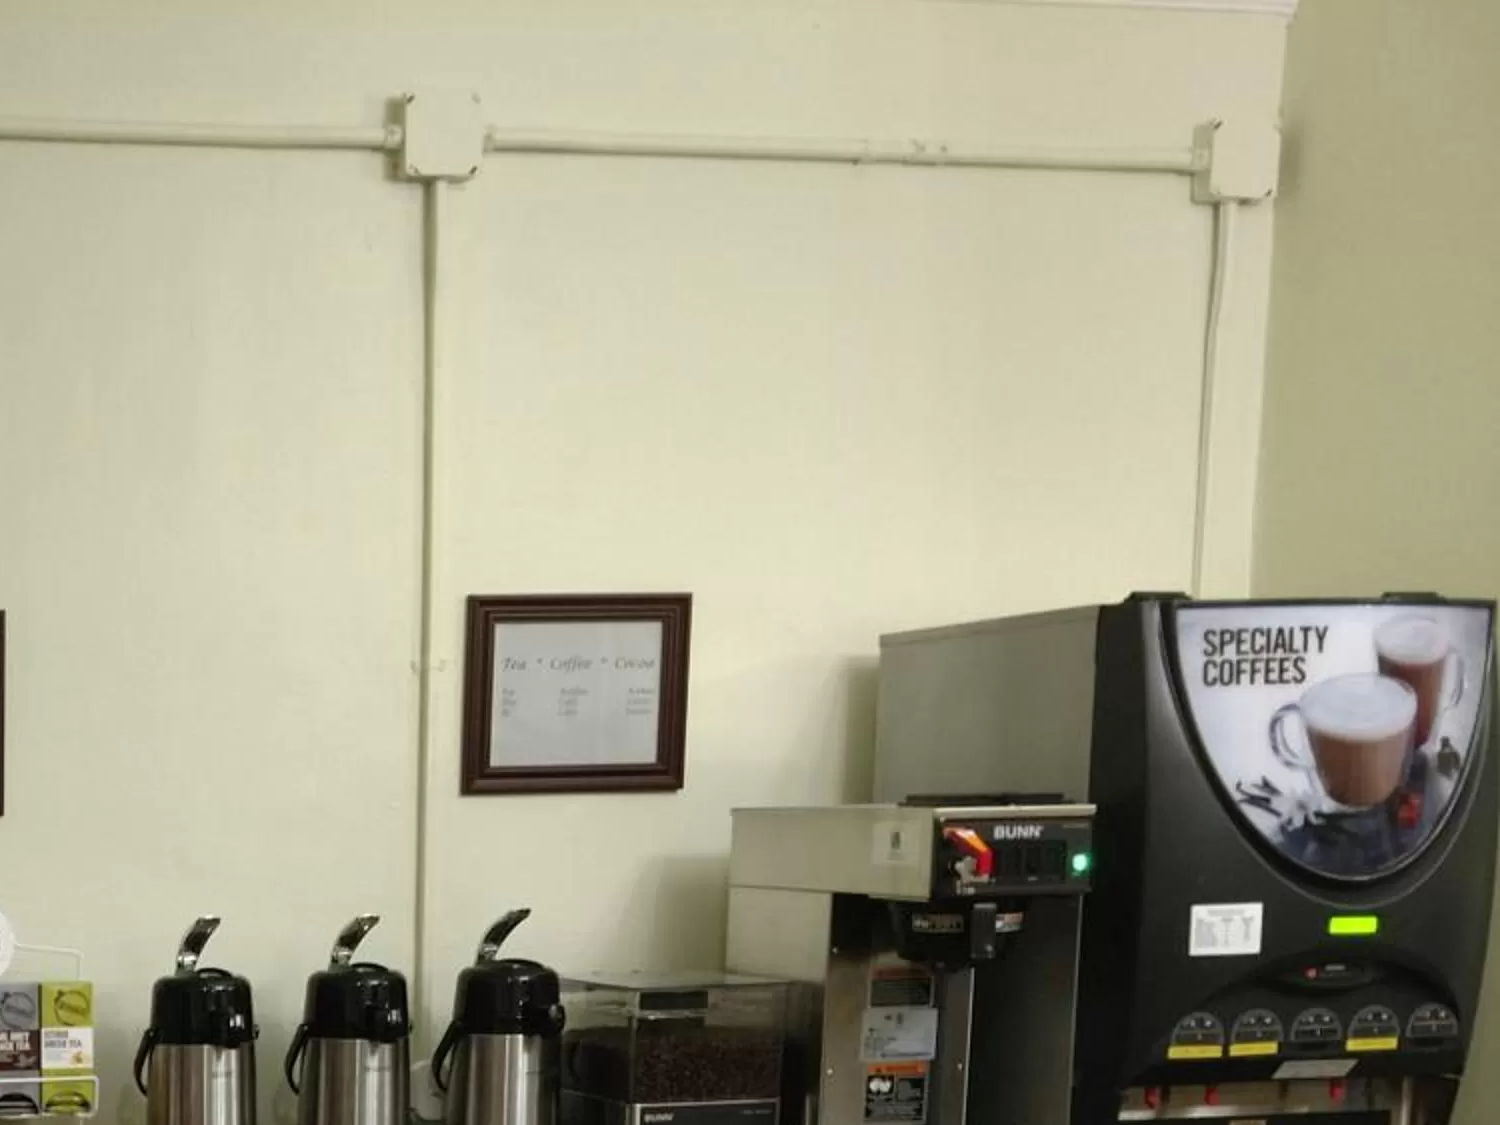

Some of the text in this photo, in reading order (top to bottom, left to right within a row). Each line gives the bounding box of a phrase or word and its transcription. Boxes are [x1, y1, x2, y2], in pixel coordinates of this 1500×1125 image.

[1203, 624, 1329, 657] SPECIALTY
[1203, 656, 1306, 687] COFFEES
[993, 825, 1042, 840] BUNN
